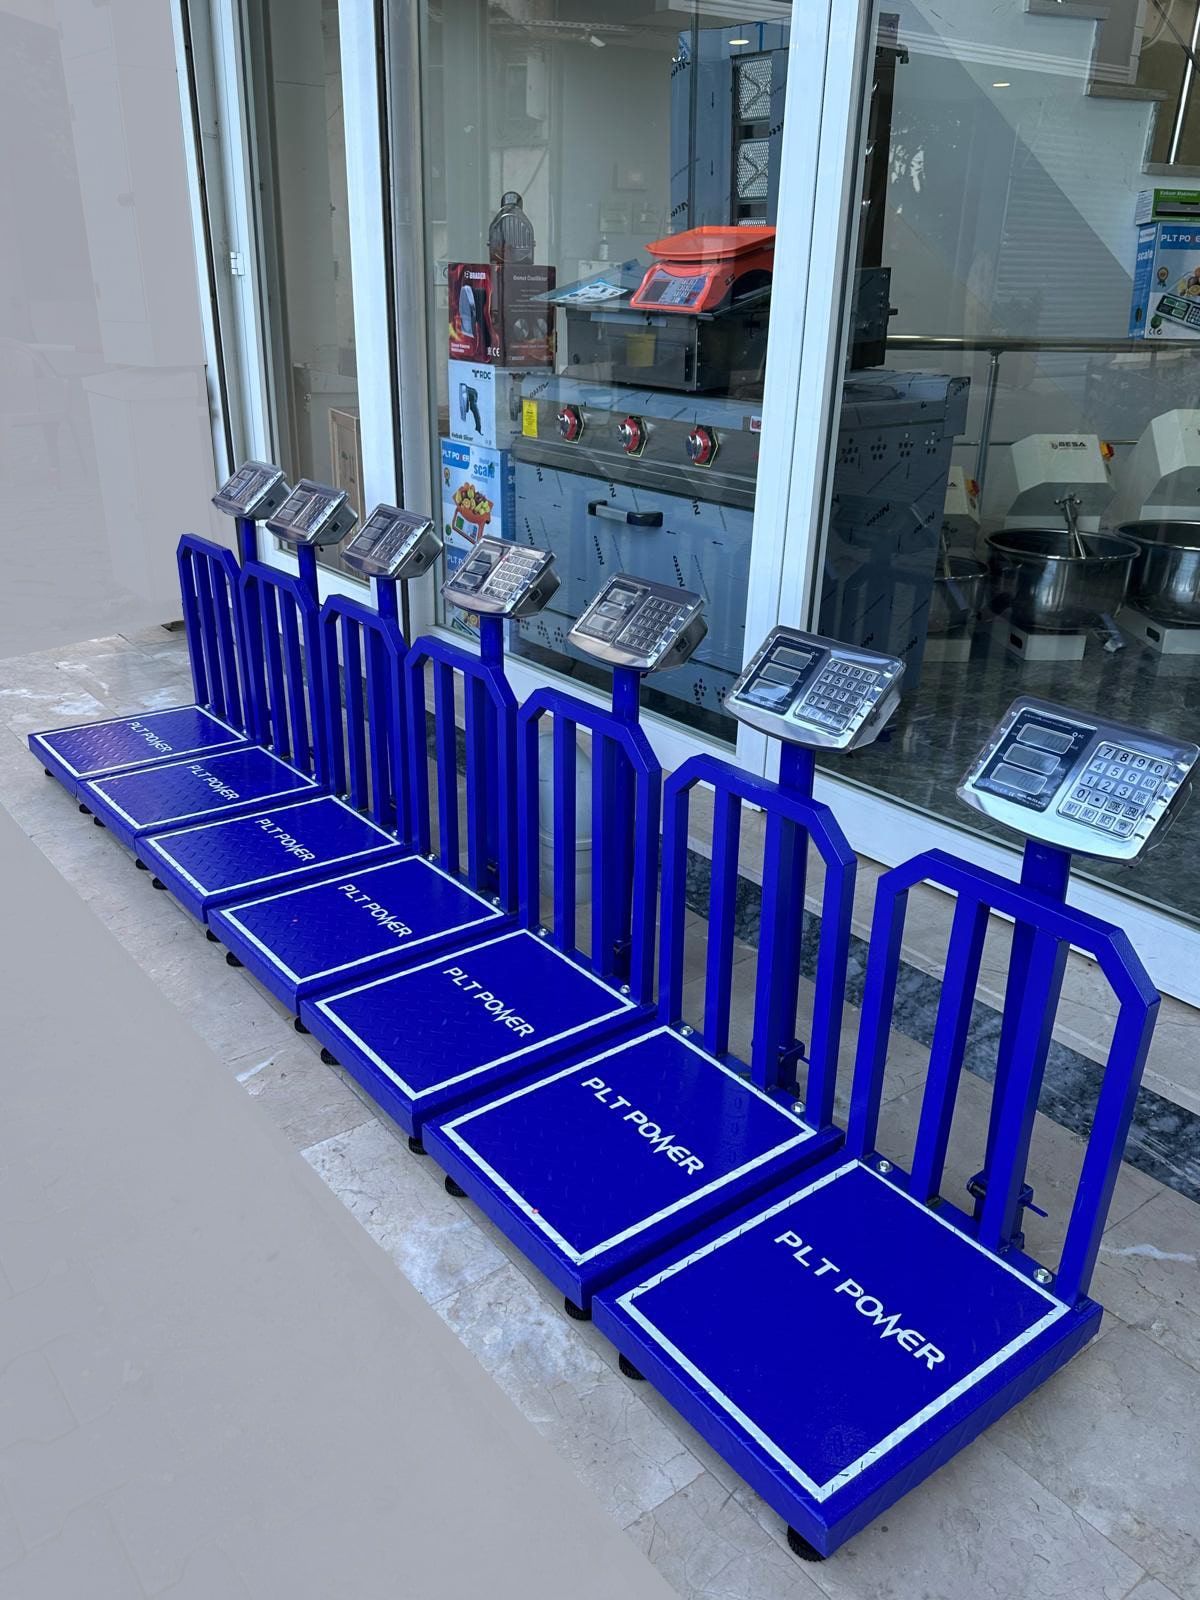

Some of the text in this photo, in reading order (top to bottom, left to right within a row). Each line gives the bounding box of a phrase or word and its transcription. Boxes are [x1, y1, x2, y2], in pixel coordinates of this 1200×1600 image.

[1160, 234, 1178, 242] PLT
[1137, 249, 1153, 261] scale
[442, 450, 452, 459] PLT
[593, 535, 605, 566] Nitto
[672, 555, 686, 588] Nitto
[127, 721, 173, 753] PLT POWER
[1103, 747, 1163, 774] 7 8 9 C
[1110, 767, 1120, 777] 5
[1128, 773, 1138, 782] 6
[187, 764, 240, 801] PLT POWER
[1076, 789, 1086, 799] 0
[1101, 781, 1112, 791] 2
[1119, 786, 1129, 797] 3
[1067, 802, 1113, 824] M1 M2 M3
[255, 818, 316, 862] PLT POWER
[337, 883, 413, 938] PLT POWER
[443, 966, 535, 1038] PLT POWER
[581, 1077, 705, 1176] PLT POWER
[774, 1230, 946, 1371] PLT POWER
